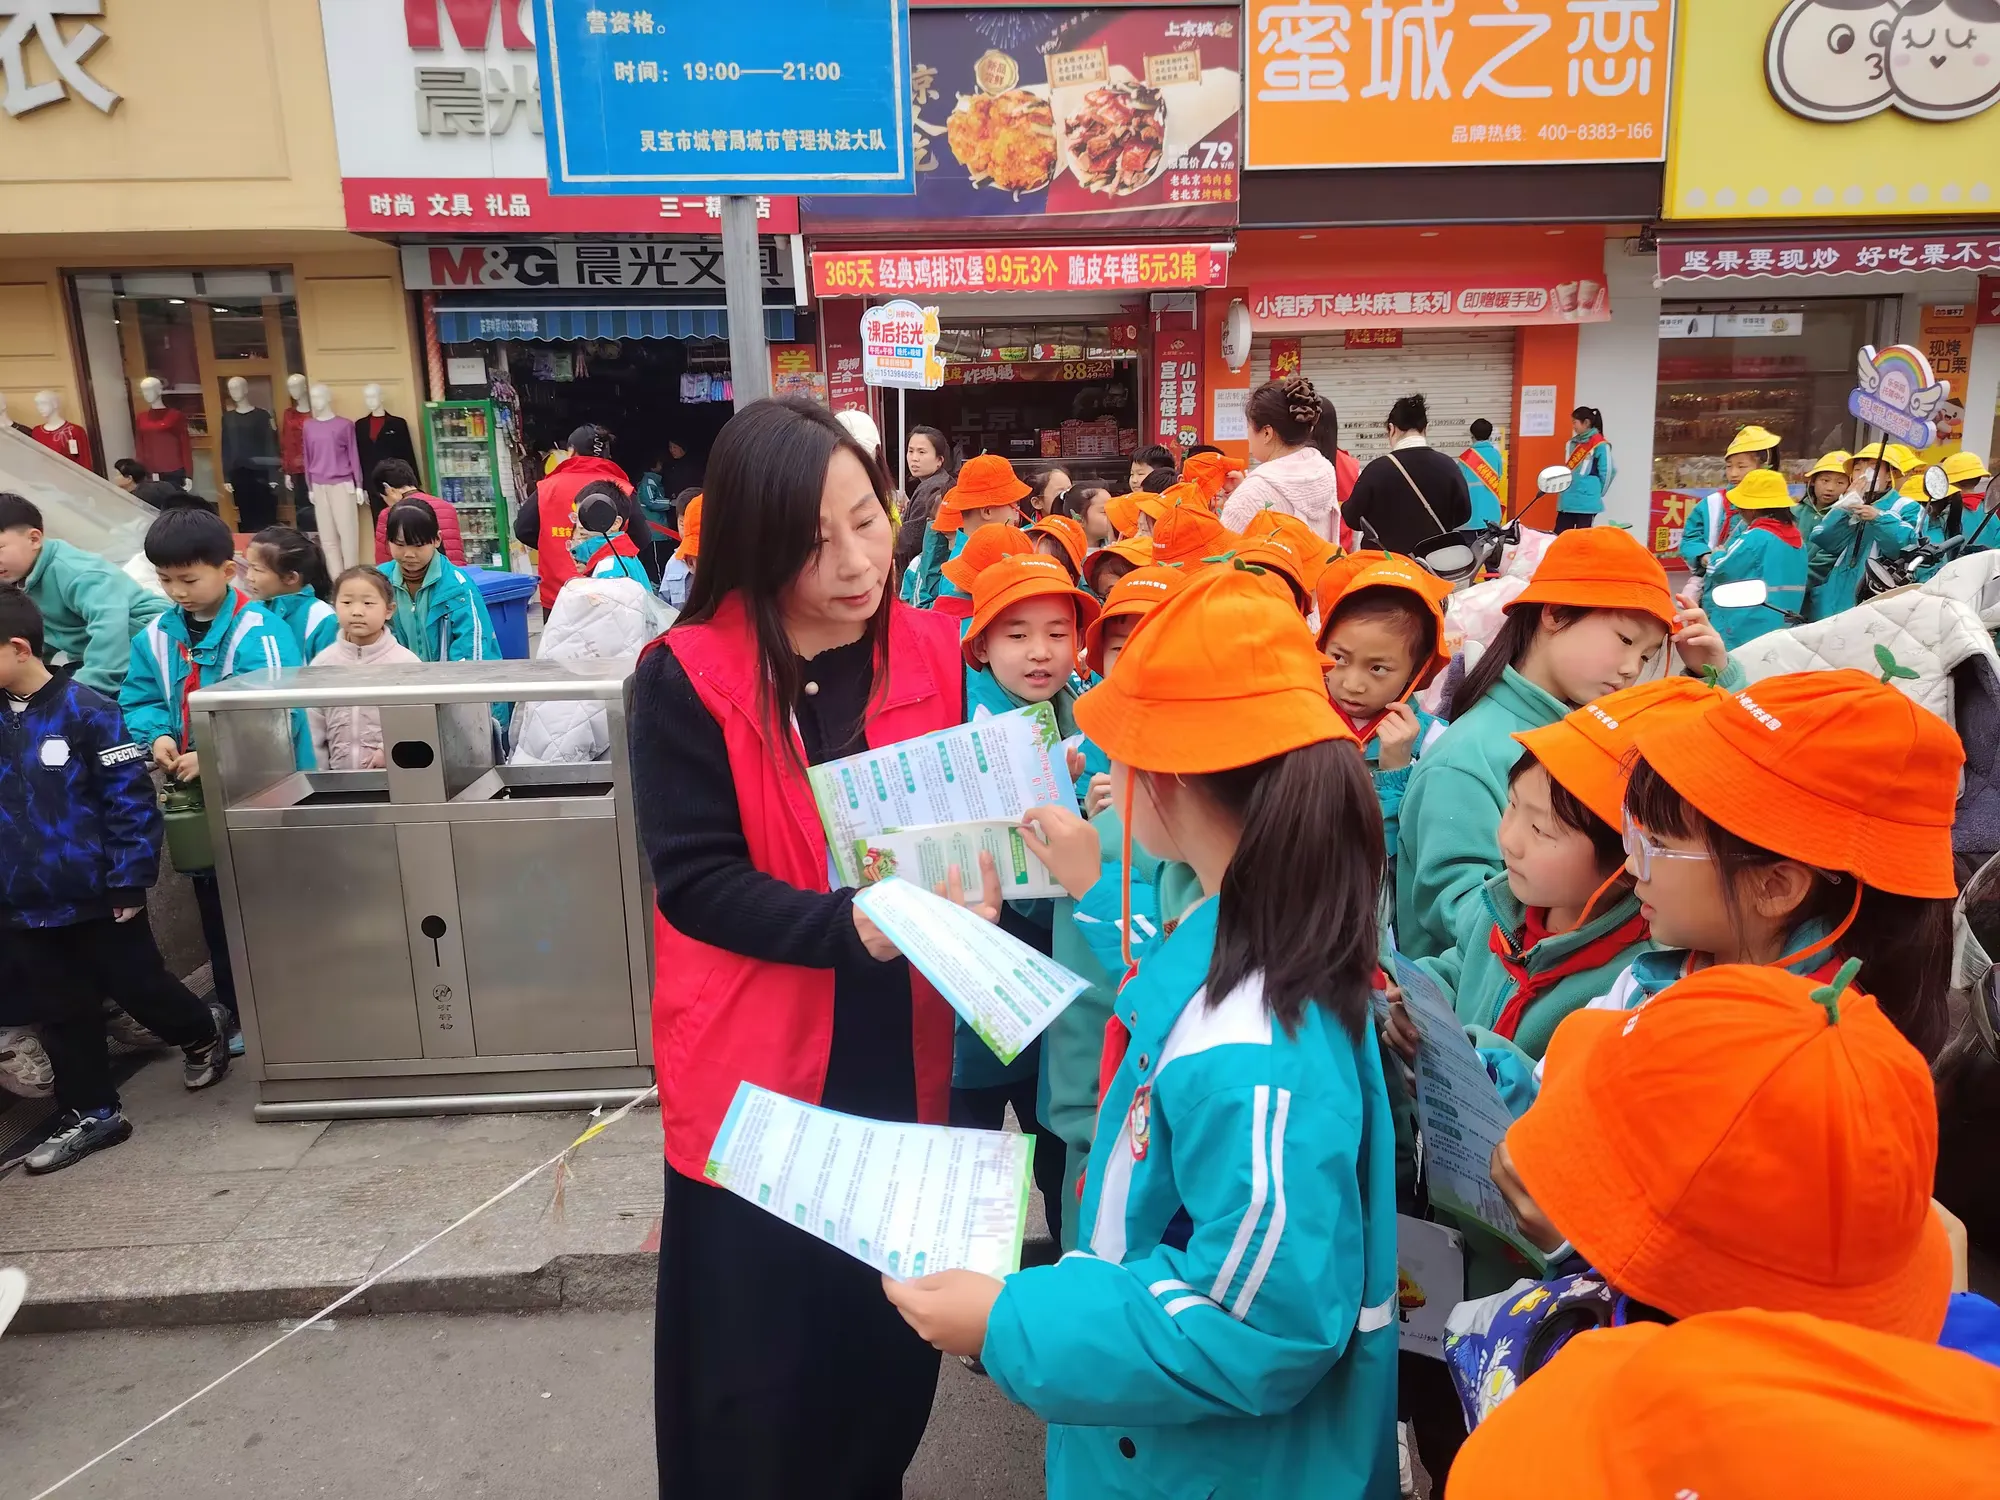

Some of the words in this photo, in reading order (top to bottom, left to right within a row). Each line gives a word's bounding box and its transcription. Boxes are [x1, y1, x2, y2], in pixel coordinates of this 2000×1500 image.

[586, 11, 666, 35] 营资格。
[1257, 0, 1659, 102] 蜜城之恋
[416, 66, 542, 135] 晨光
[640, 129, 886, 152] 灵宝市城管局城市管理执法大队
[1537, 123, 1653, 141] 400-8383-166
[1200, 142, 1233, 169] 7.9
[370, 195, 415, 216] 时尚
[428, 195, 473, 216] 文具
[486, 194, 530, 216] 礼品
[659, 196, 771, 219] 三一精店
[429, 246, 557, 285] M&G
[576, 246, 783, 285] 晨光文具
[825, 258, 875, 289] 365天
[879, 254, 1058, 287] 经典鸡排汉堡9.9元3个
[1068, 252, 1198, 284] 脆皮年糕5元3串
[1681, 248, 1840, 271] 坚果要现炒
[1255, 291, 1452, 318] 小程序下单米麻薯系列
[867, 320, 924, 345] 课后拾光
[1929, 340, 1961, 356] 现烤
[777, 350, 810, 373] 学
[830, 370, 863, 384] 三合一
[1180, 361, 1197, 416] 小叉骨
[1160, 361, 1178, 436] 宫廷怪味
[1178, 431, 1197, 446] 9.9
